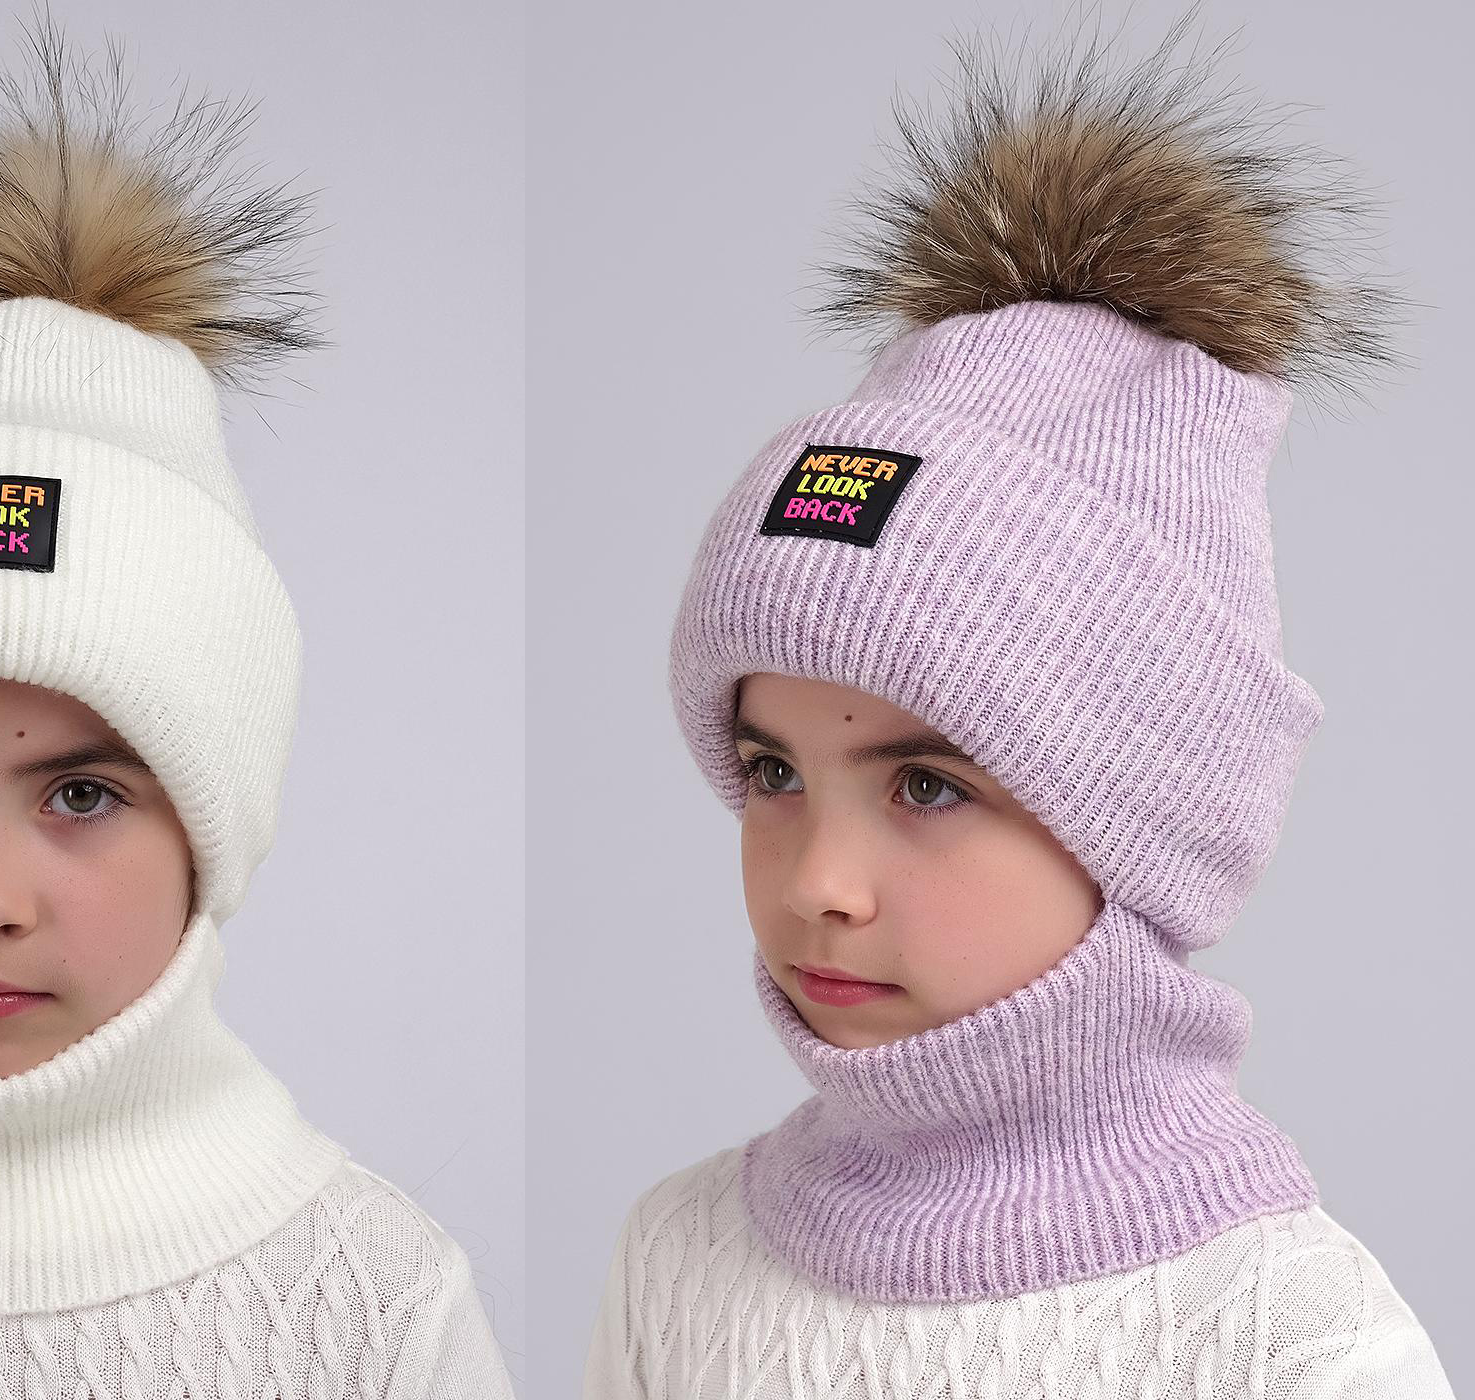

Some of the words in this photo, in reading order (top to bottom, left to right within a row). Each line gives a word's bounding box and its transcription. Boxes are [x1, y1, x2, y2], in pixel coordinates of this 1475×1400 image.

[803, 453, 899, 481] NEVER
[796, 473, 873, 501] LOOK
[782, 496, 862, 526] BACK
